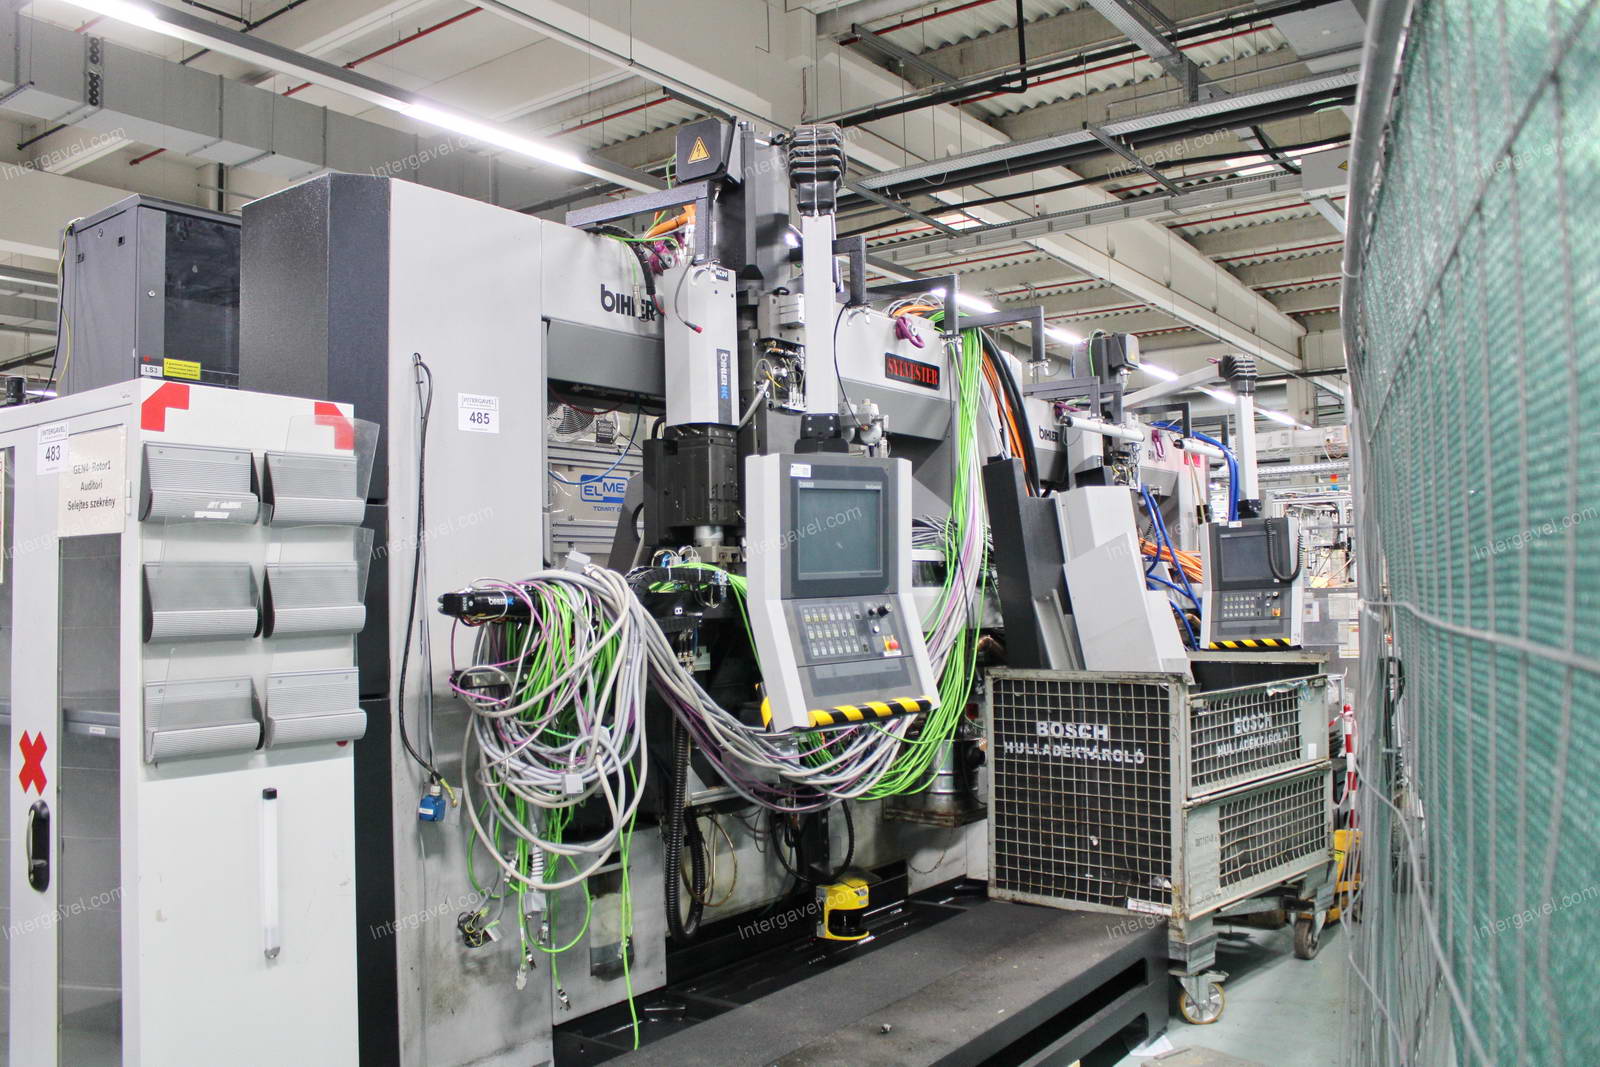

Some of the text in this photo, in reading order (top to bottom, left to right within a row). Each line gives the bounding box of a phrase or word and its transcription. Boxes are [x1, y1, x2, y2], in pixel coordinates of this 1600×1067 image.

[888, 358, 938, 384] SYLVESTER
[470, 411, 490, 425] 485
[45, 444, 61, 461] 483
[1036, 720, 1109, 741] BOSCH
[1234, 713, 1272, 735] BOSCH
[1003, 741, 1145, 764] HULLADÉKTÁROLÓ
